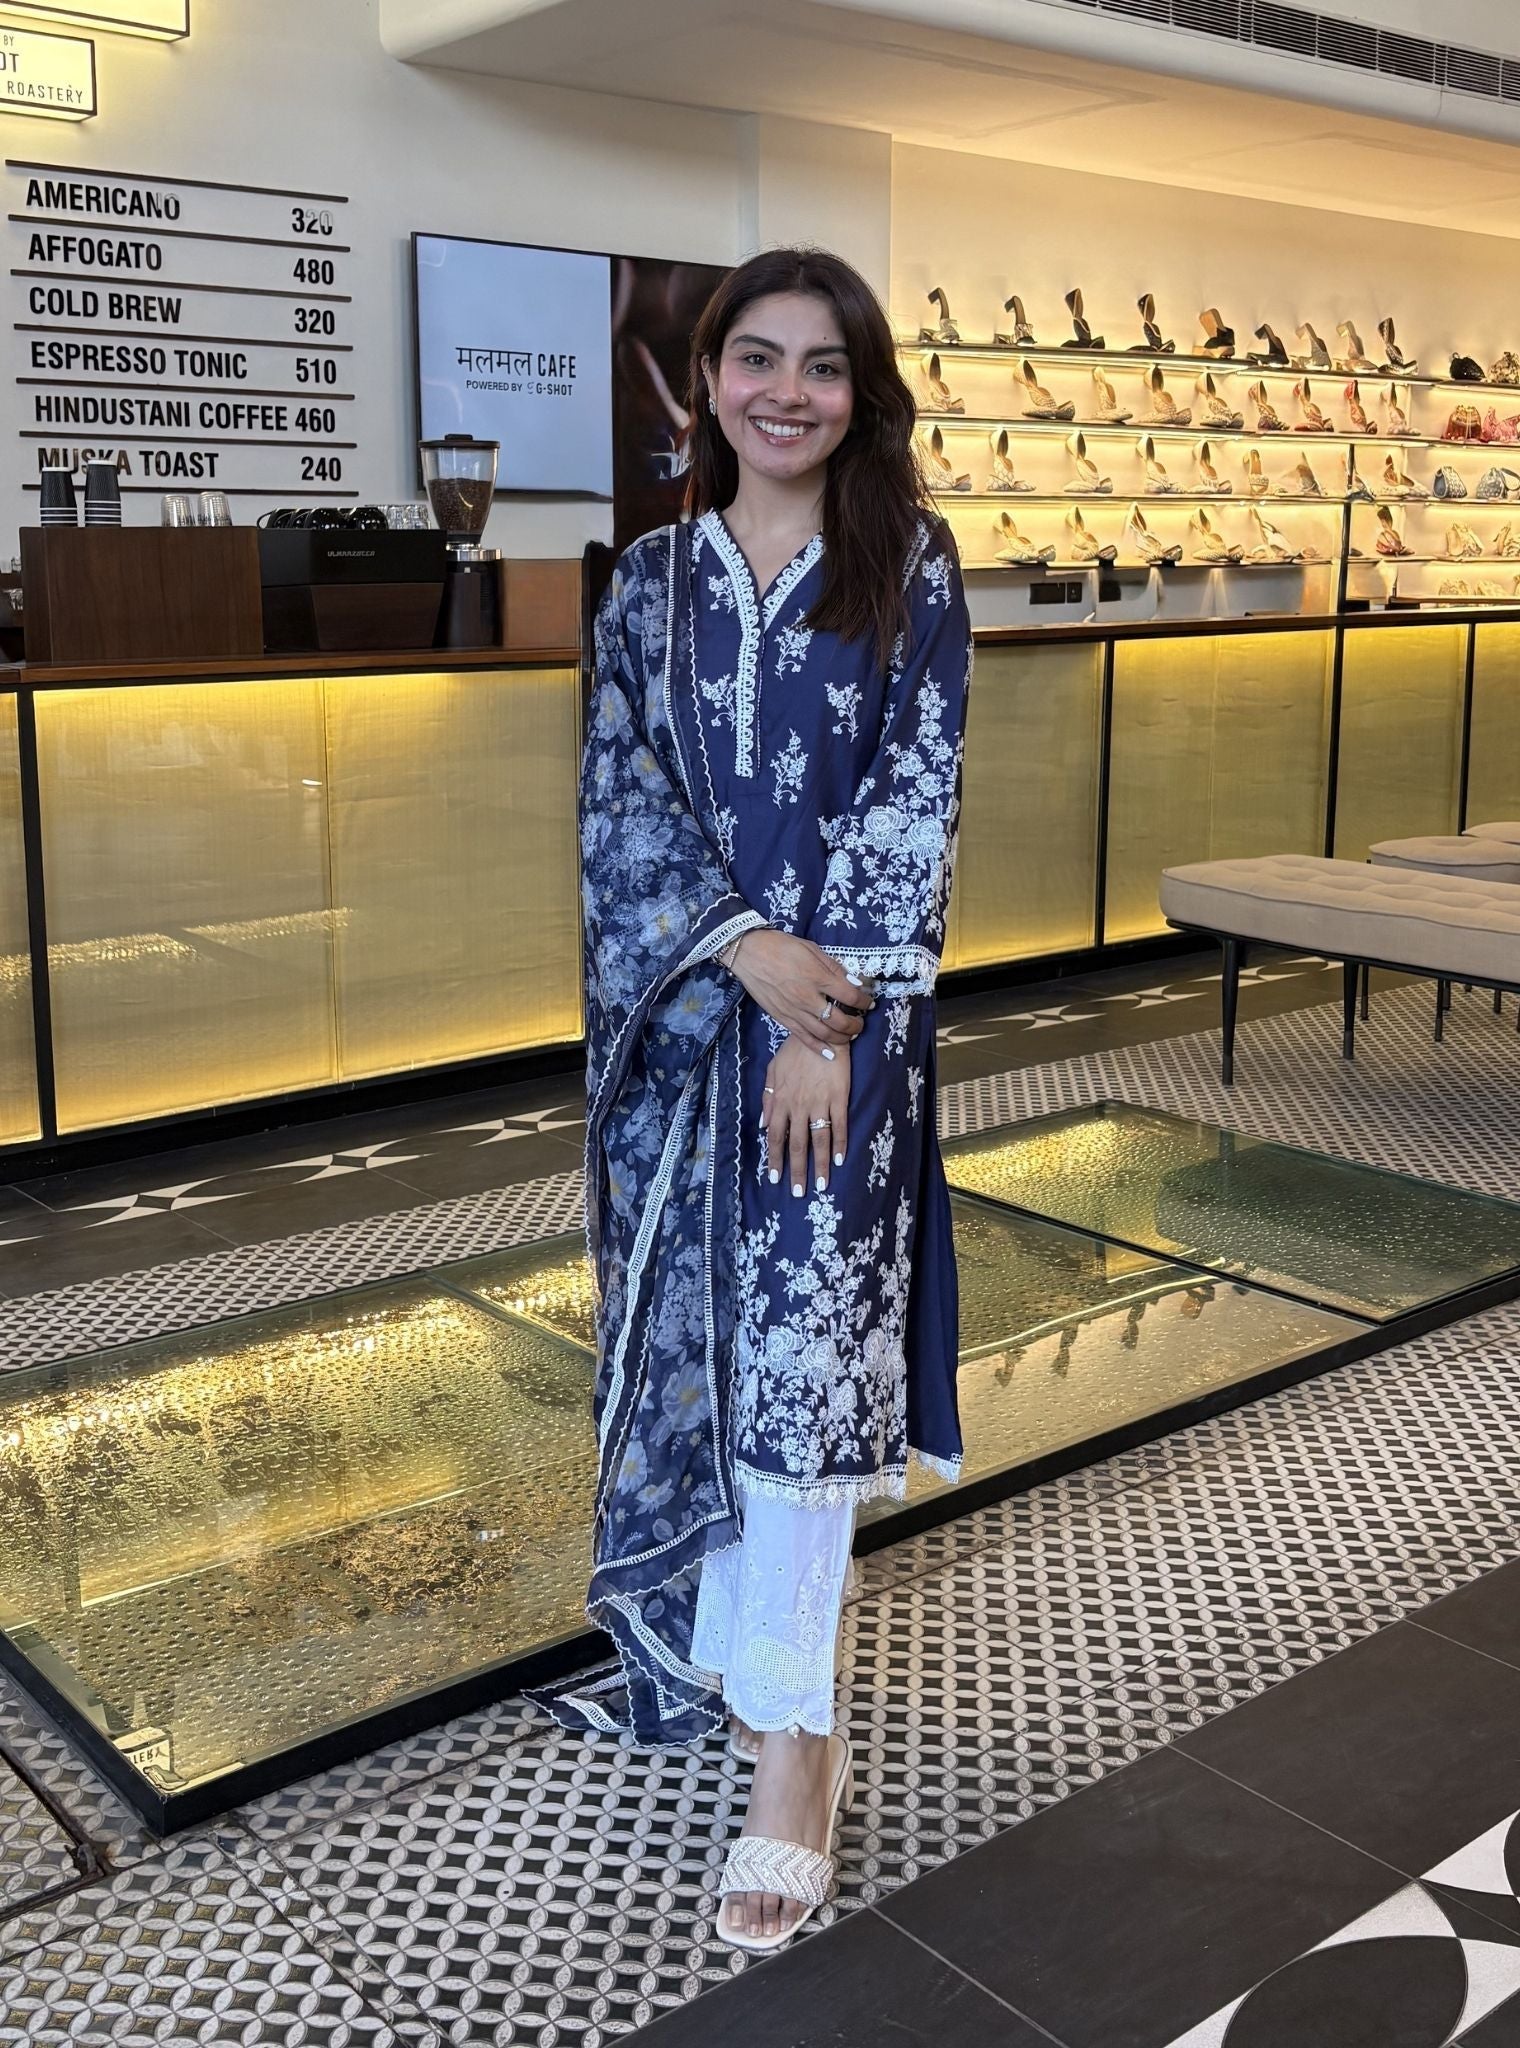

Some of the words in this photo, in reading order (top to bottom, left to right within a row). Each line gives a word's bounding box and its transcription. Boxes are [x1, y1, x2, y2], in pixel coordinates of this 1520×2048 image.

[3, 34, 15, 47] BY
[7, 80, 83, 104] ROASTERY
[26, 179, 181, 221] AMERICANO
[291, 207, 334, 236] 320
[28, 233, 163, 271] AFFOGATO
[292, 257, 335, 286] 480
[29, 286, 99, 318] COLD
[108, 293, 182, 324] BREW
[294, 307, 336, 335] 320
[31, 341, 167, 375] ESPRESSO
[174, 349, 248, 379] TONIC
[296, 357, 337, 384] 510
[455, 347, 533, 377] मलमल
[537, 353, 577, 379] CAFE
[466, 380, 510, 392] POWERED
[511, 383, 523, 392] BY
[35, 395, 191, 427] HINDUSTANI
[199, 402, 288, 431] COFFEE
[295, 407, 336, 433] 460
[139, 450, 219, 478] TOAST
[301, 456, 342, 482] 240
